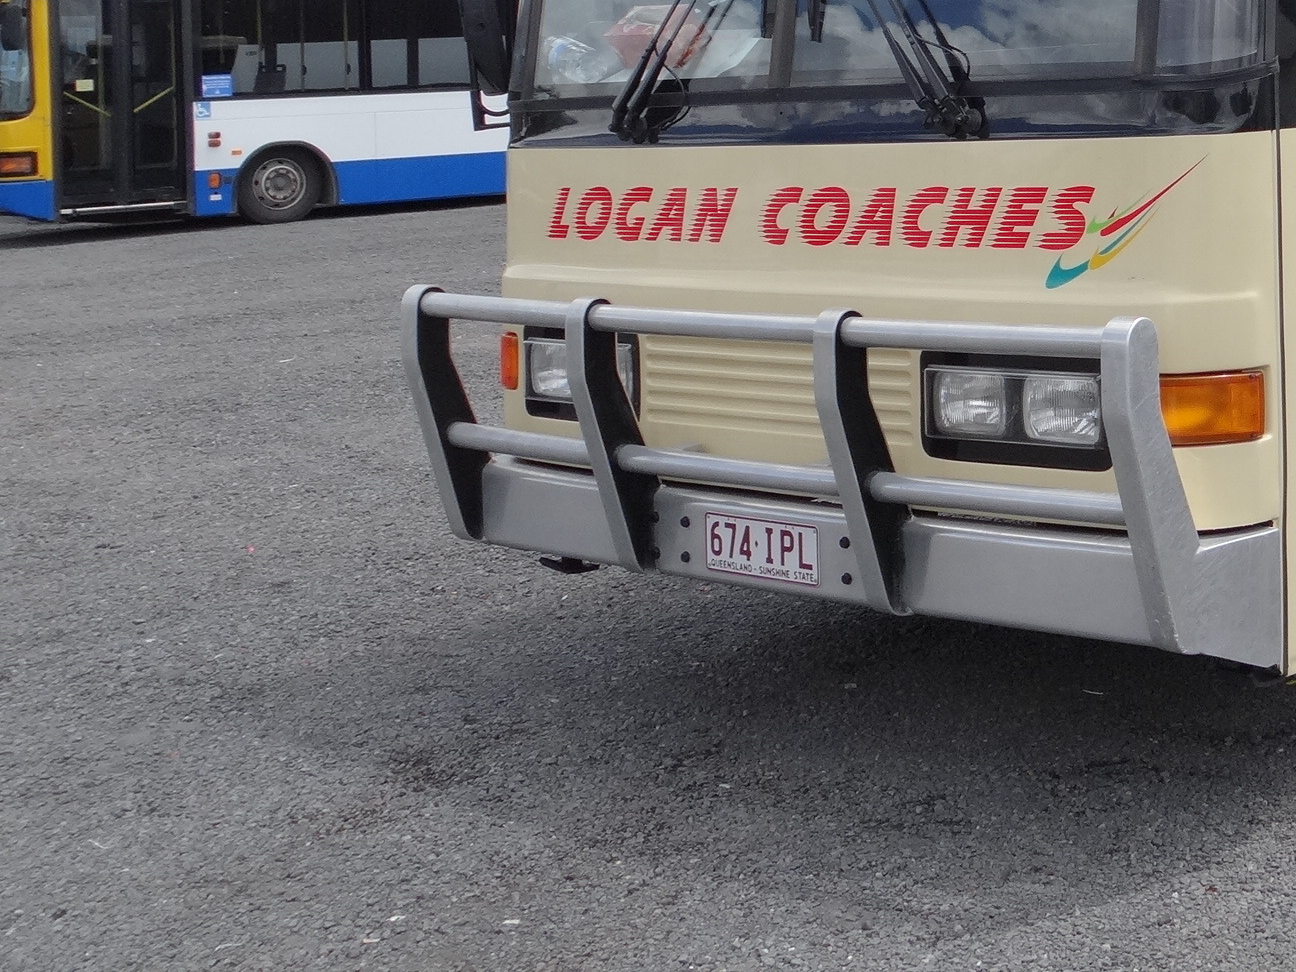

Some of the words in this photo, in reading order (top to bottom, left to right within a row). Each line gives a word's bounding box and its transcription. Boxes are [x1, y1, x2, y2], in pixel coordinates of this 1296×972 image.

[547, 186, 738, 243] LOGAN
[757, 186, 1098, 251] COACHES
[710, 521, 752, 561] 674
[765, 527, 813, 570] IPL
[711, 558, 752, 573] QUEENSLAND
[759, 566, 790, 578] SUNSHINE
[794, 572, 814, 582] STATE
